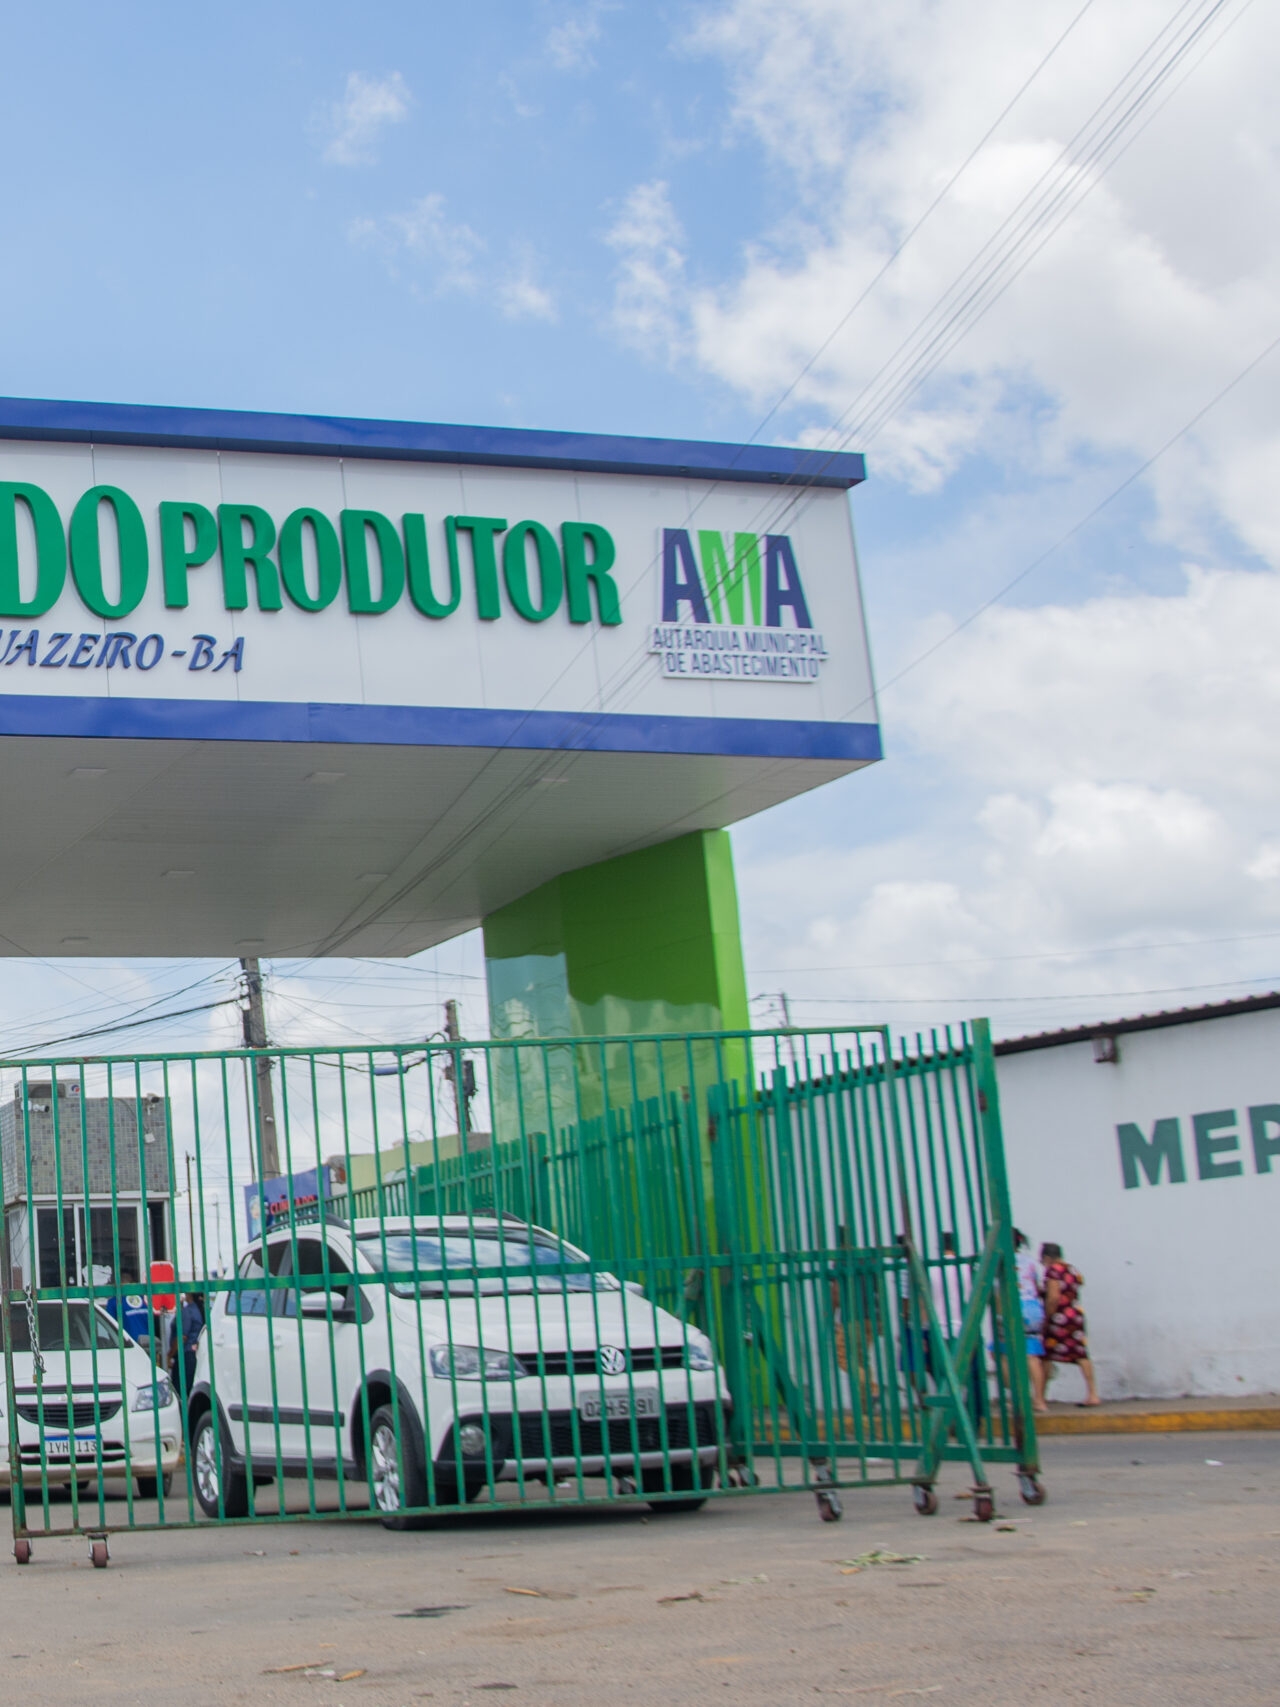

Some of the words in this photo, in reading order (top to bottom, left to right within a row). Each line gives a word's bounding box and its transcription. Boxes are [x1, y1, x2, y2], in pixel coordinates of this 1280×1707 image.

[159, 501, 623, 626] PRODUTOR
[662, 528, 813, 629] AMA
[653, 628, 739, 651] AUTARQUIA
[744, 630, 828, 655] MUNICIPAL
[665, 652, 687, 673] DE
[691, 653, 819, 678] ABASTECIMENTO
